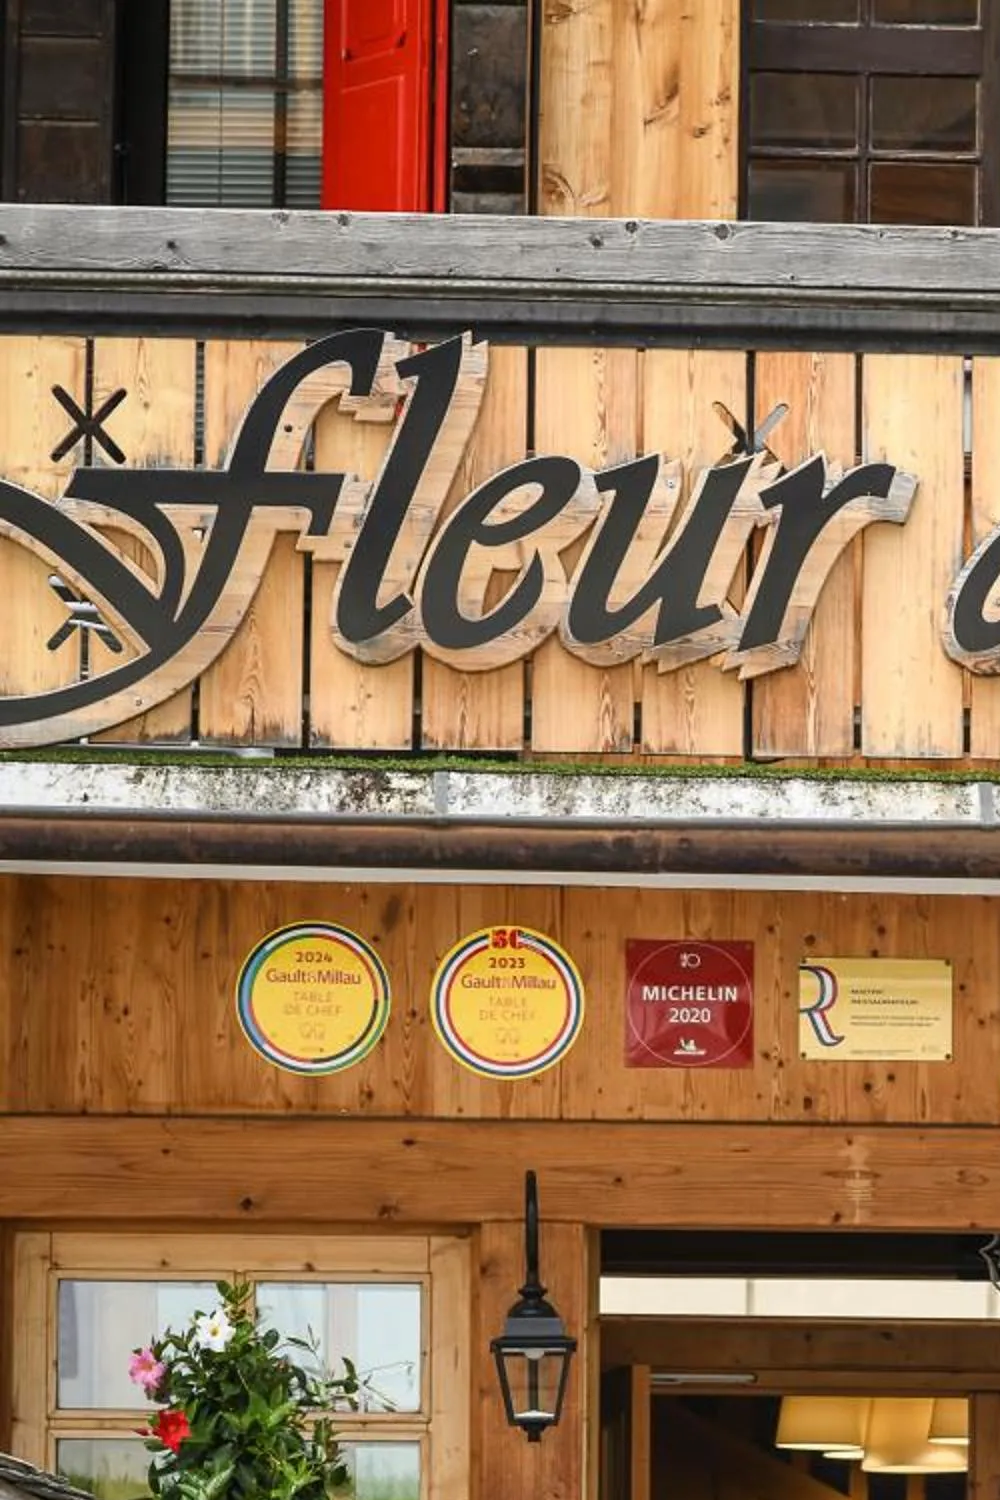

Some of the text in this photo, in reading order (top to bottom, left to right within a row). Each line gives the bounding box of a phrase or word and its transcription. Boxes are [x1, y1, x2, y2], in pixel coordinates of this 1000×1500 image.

[295, 951, 333, 963] 2024
[488, 957, 526, 969] 2023
[642, 985, 738, 1002] MICHELIN
[668, 1007, 712, 1024] 2020
